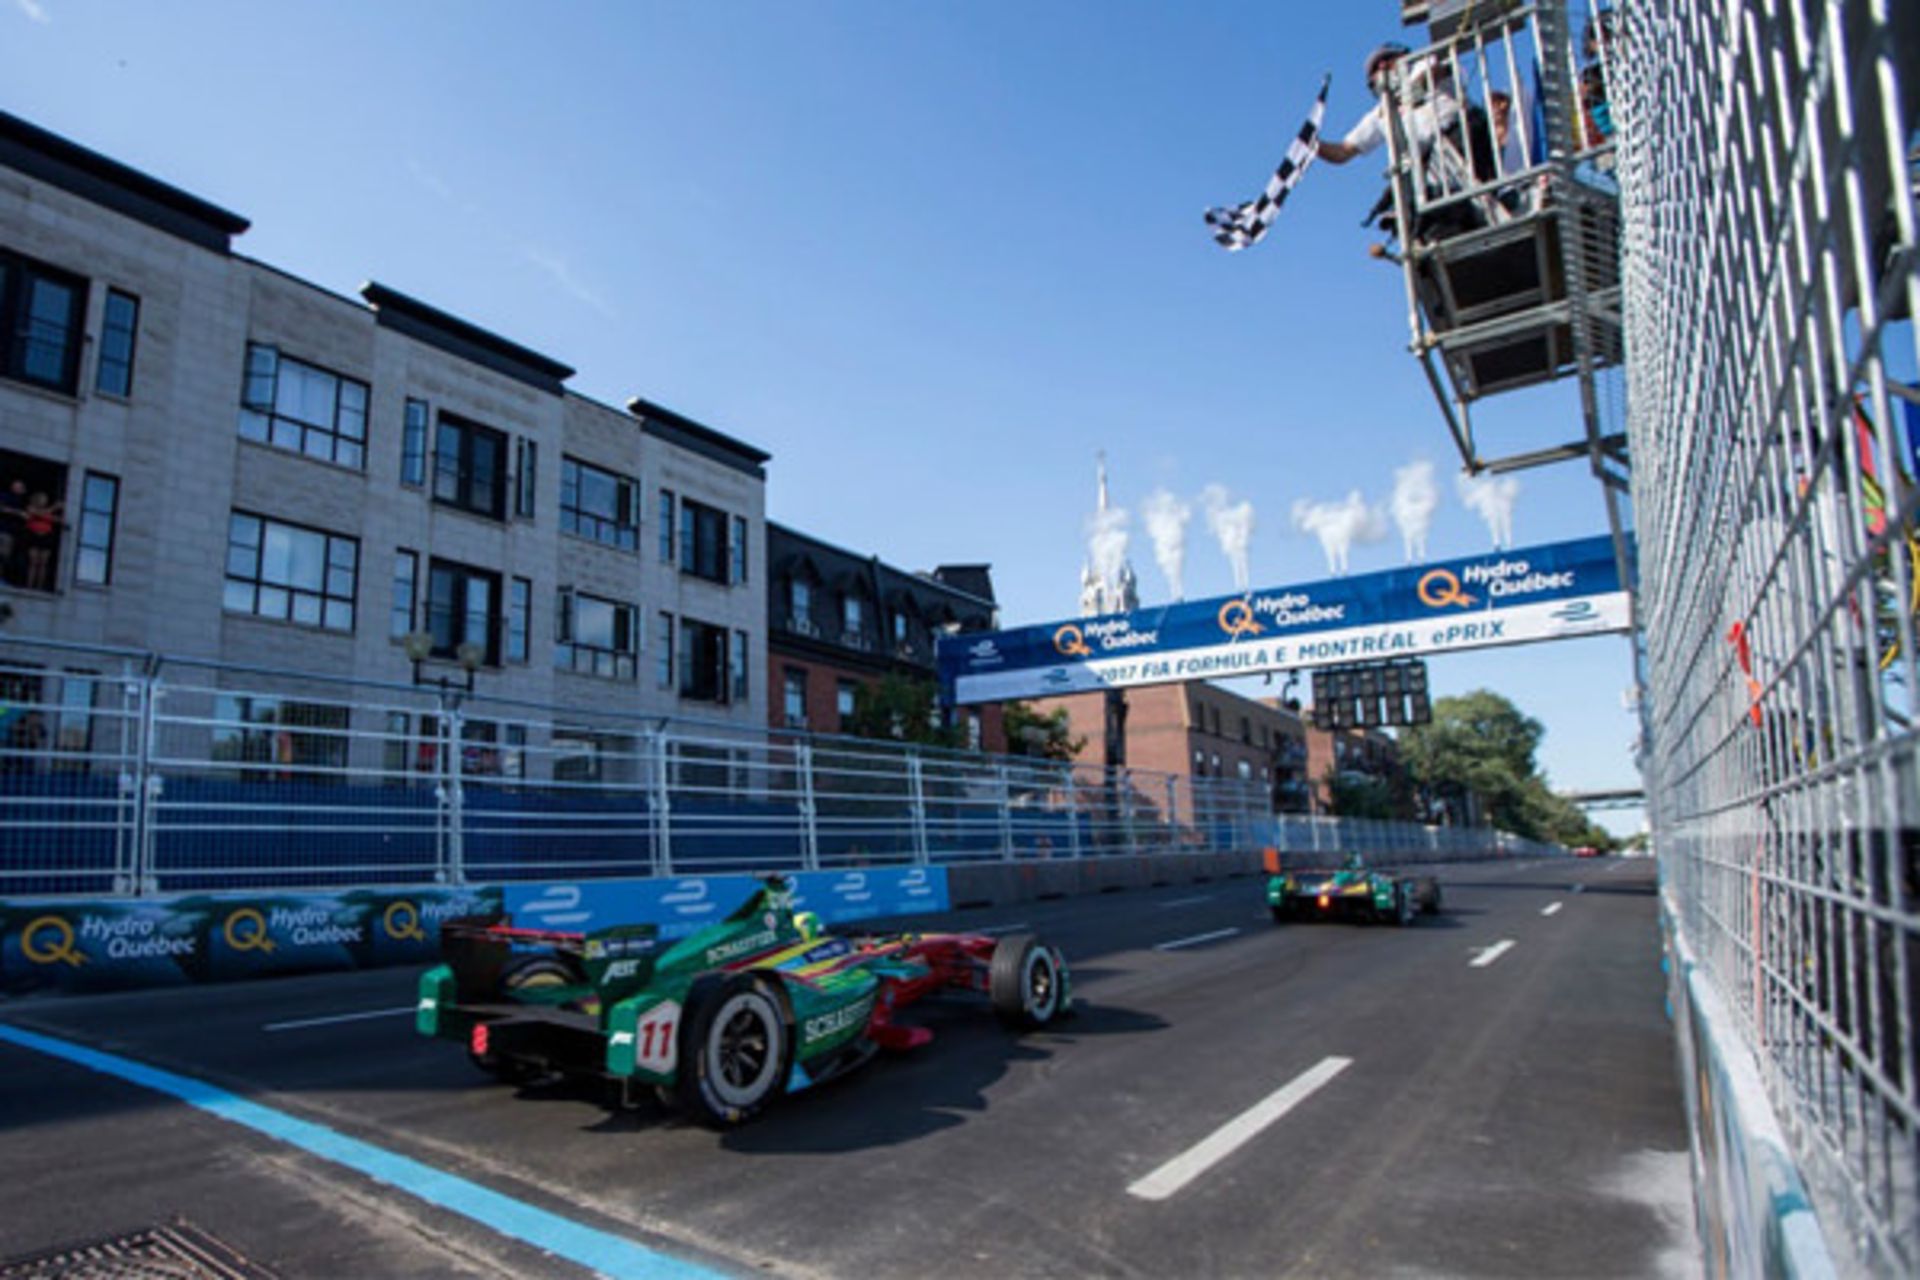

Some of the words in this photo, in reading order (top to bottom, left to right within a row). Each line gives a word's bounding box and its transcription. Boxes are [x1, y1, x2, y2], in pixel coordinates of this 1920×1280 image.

[1463, 559, 1530, 585] Hydro
[1488, 570, 1575, 598] Québec
[1255, 592, 1310, 614] Hydro
[1275, 604, 1345, 627] Québec
[1084, 619, 1130, 638] Hydro
[1102, 631, 1159, 650] Québec
[1101, 665, 1137, 683] 2017
[1142, 660, 1170, 678] FIA
[1177, 648, 1268, 675] FORMULA
[1276, 646, 1287, 663] E
[1299, 629, 1418, 660] MONTRÉAL
[1432, 619, 1505, 645] ePRIX
[81, 914, 154, 941] Hydro
[270, 906, 329, 931] Hydro
[107, 934, 197, 959] Québec
[292, 923, 364, 945] Québec
[641, 1020, 673, 1059] 11
